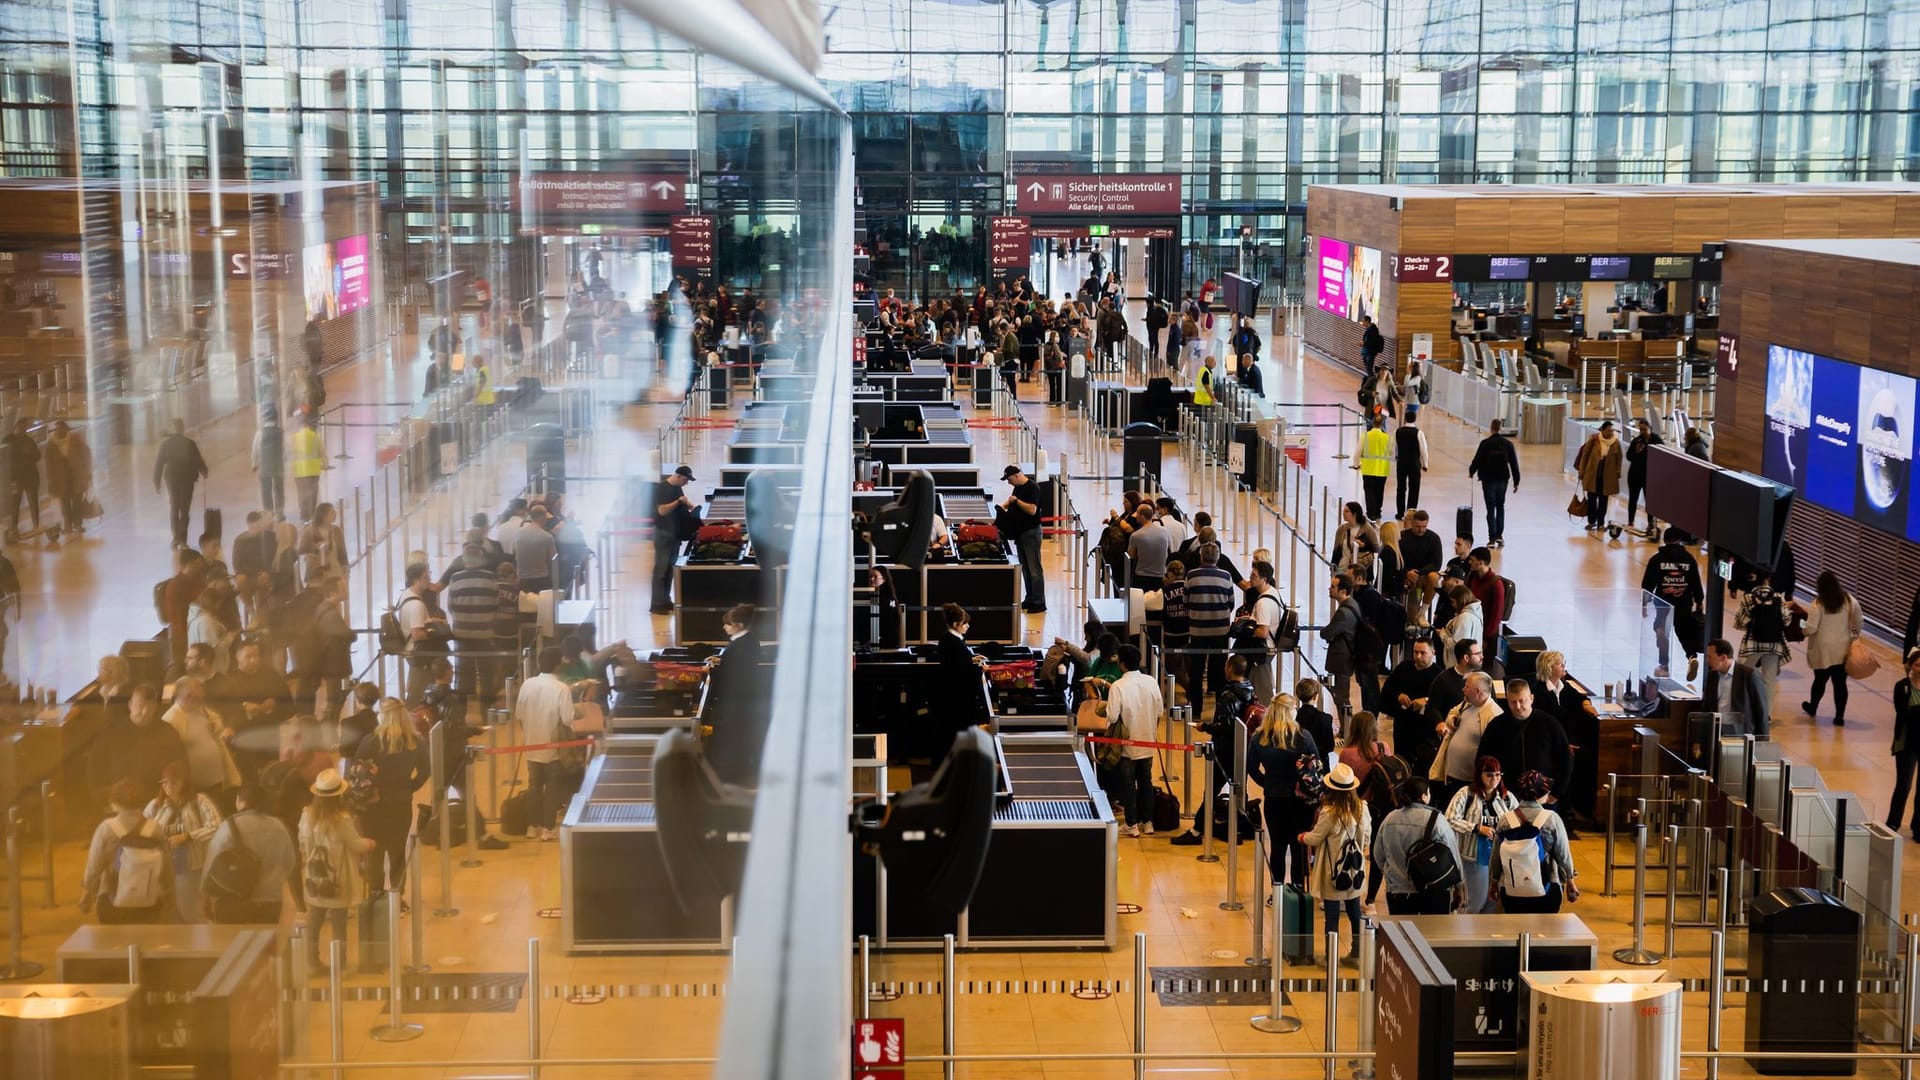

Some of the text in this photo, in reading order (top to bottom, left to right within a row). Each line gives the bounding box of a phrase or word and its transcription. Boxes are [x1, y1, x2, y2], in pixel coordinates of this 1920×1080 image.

[1068, 182, 1173, 192] Sicherheitskontrolle 1
[1068, 193, 1129, 203] Security Control
[1068, 203, 1082, 211] Alle
[1106, 203, 1116, 211] All
[1116, 203, 1135, 211] Gates
[1490, 257, 1509, 267] BER
[1535, 256, 1547, 264] 226
[1591, 257, 1609, 266] BER
[1654, 256, 1673, 266] BER
[1404, 256, 1430, 264] Check-in
[1435, 256, 1450, 278] 2
[1728, 338, 1738, 371] 4
[1663, 575, 1685, 584] Speed
[1465, 978, 1515, 993] Security
